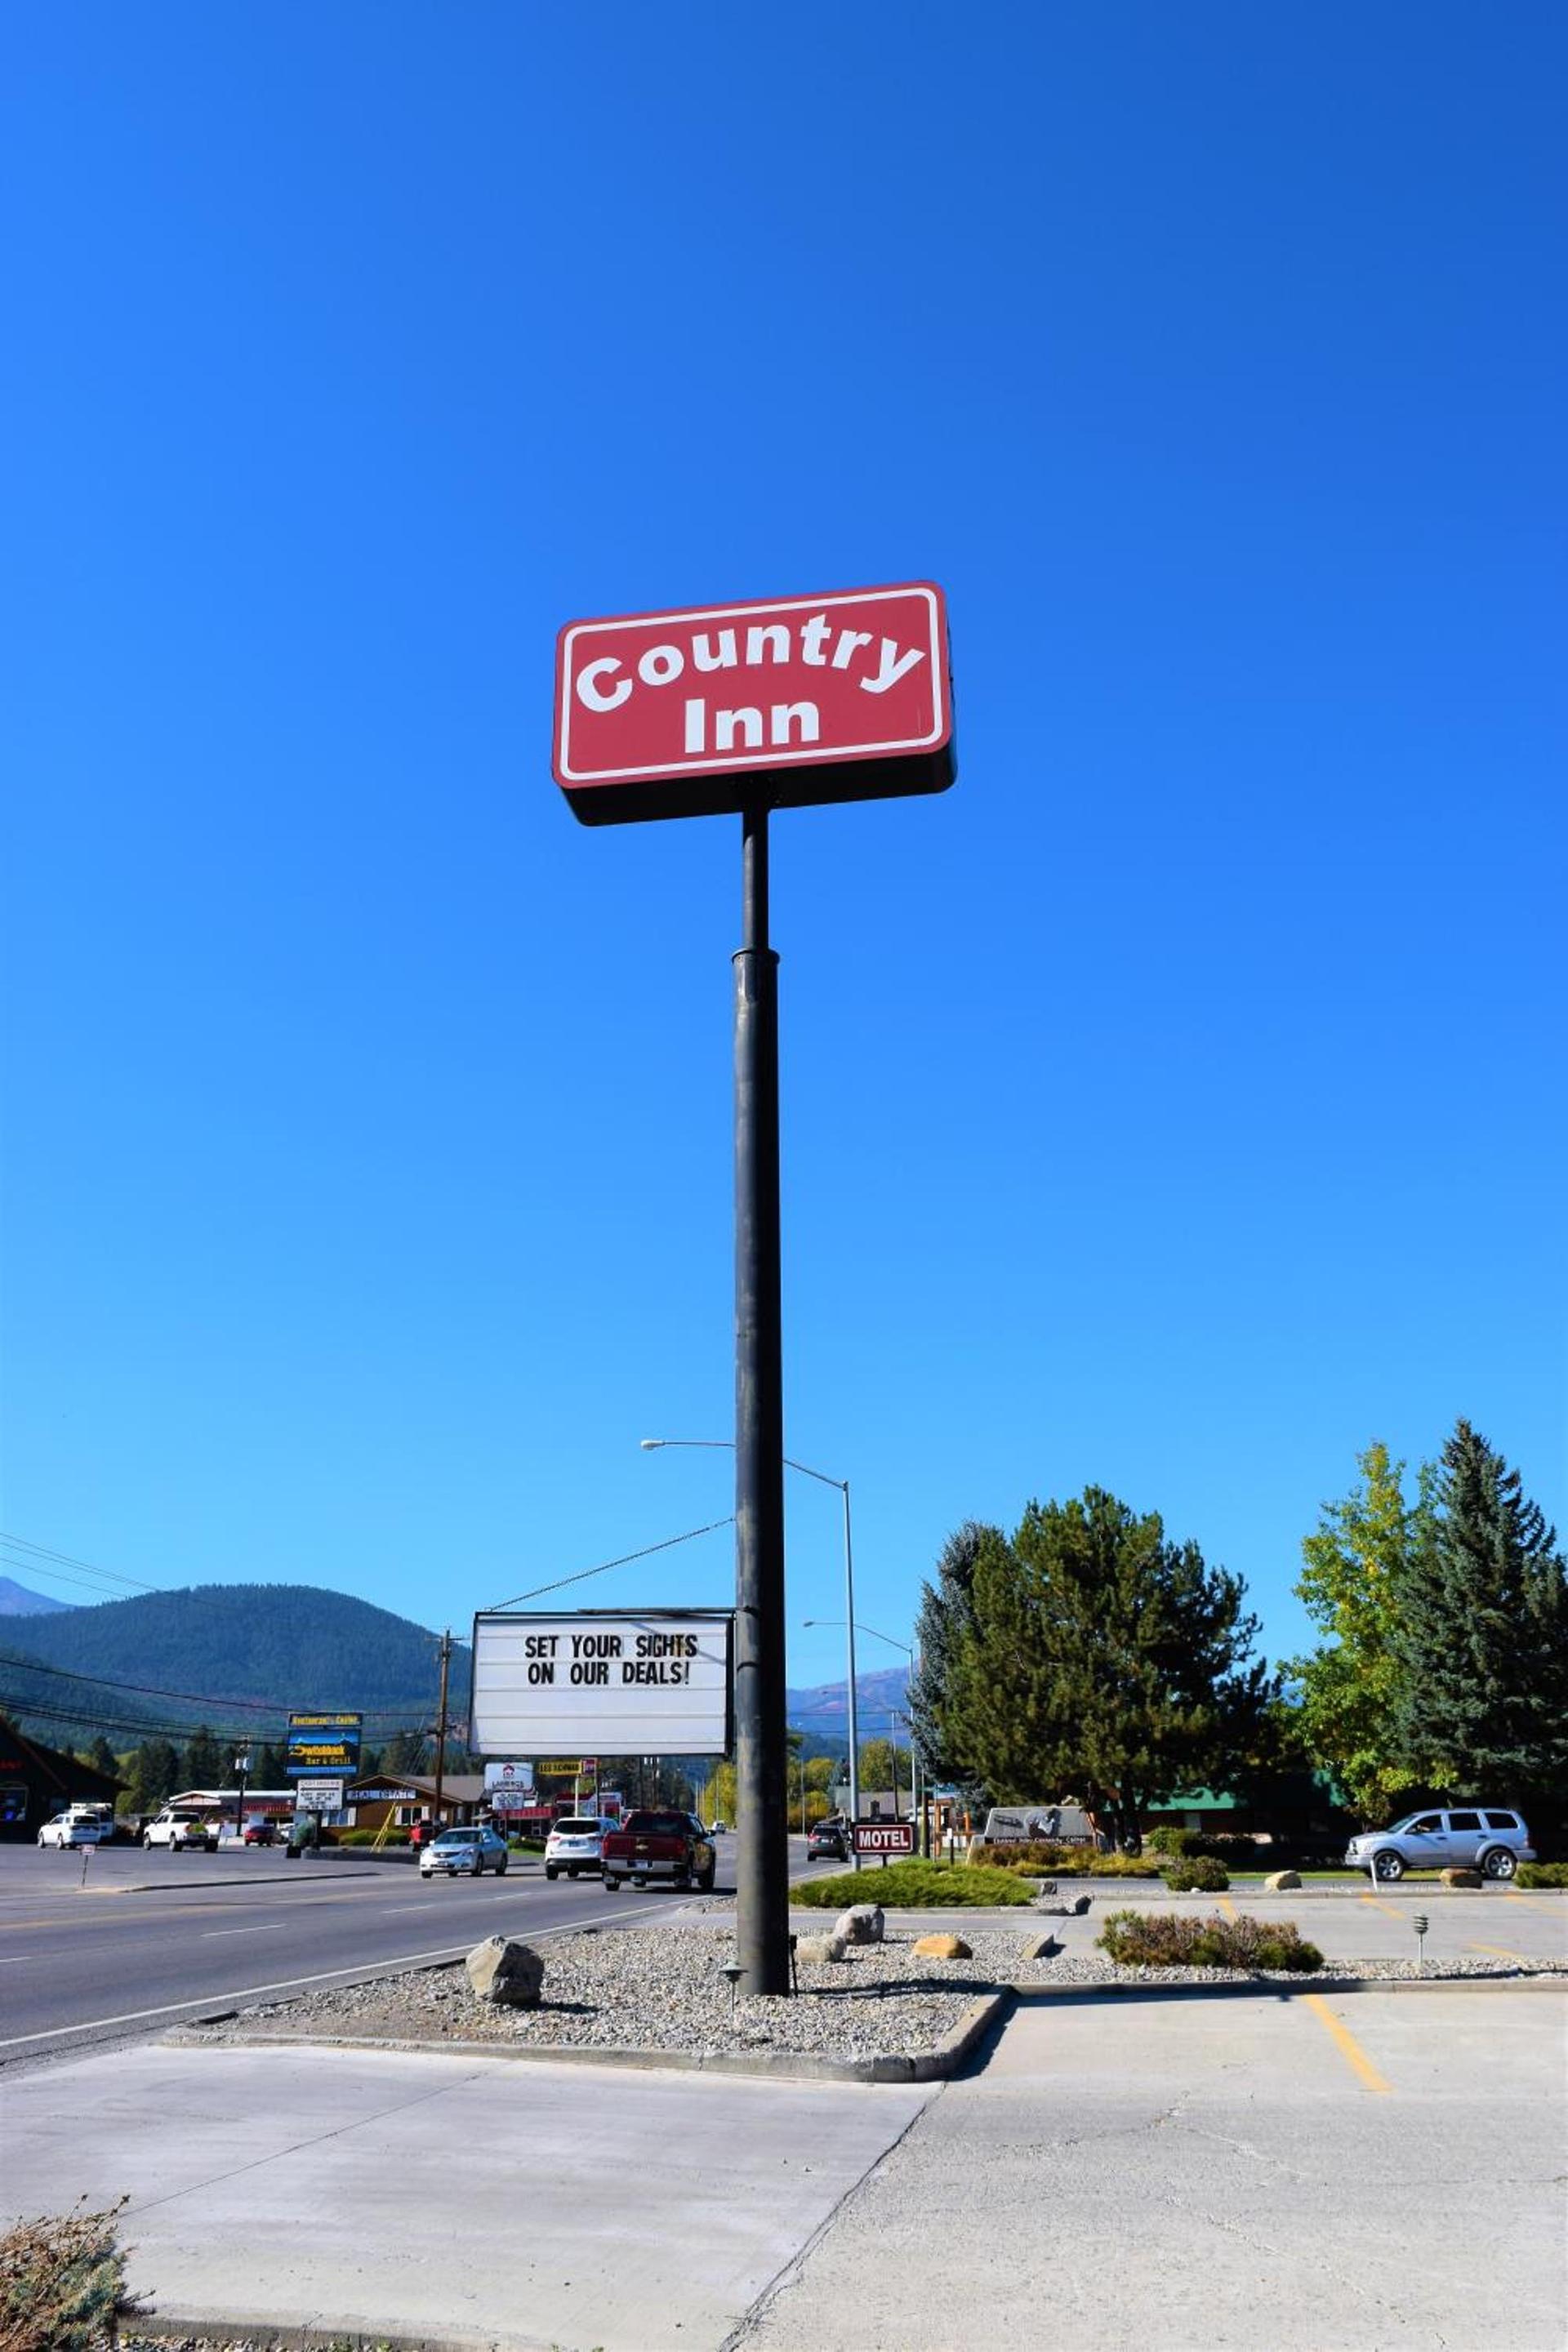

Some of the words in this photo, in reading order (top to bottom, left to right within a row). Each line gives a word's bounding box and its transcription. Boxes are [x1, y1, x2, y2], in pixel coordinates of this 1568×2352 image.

[576, 614, 926, 713] Country
[684, 698, 820, 754] Inn
[524, 1635, 559, 1659] SET
[572, 1634, 622, 1659] YOUR
[635, 1633, 698, 1659] SIGHTS
[528, 1662, 555, 1685] ON
[570, 1661, 609, 1686] OUR
[621, 1661, 690, 1686] DEALS!
[858, 1830, 909, 1847] MOTEL
